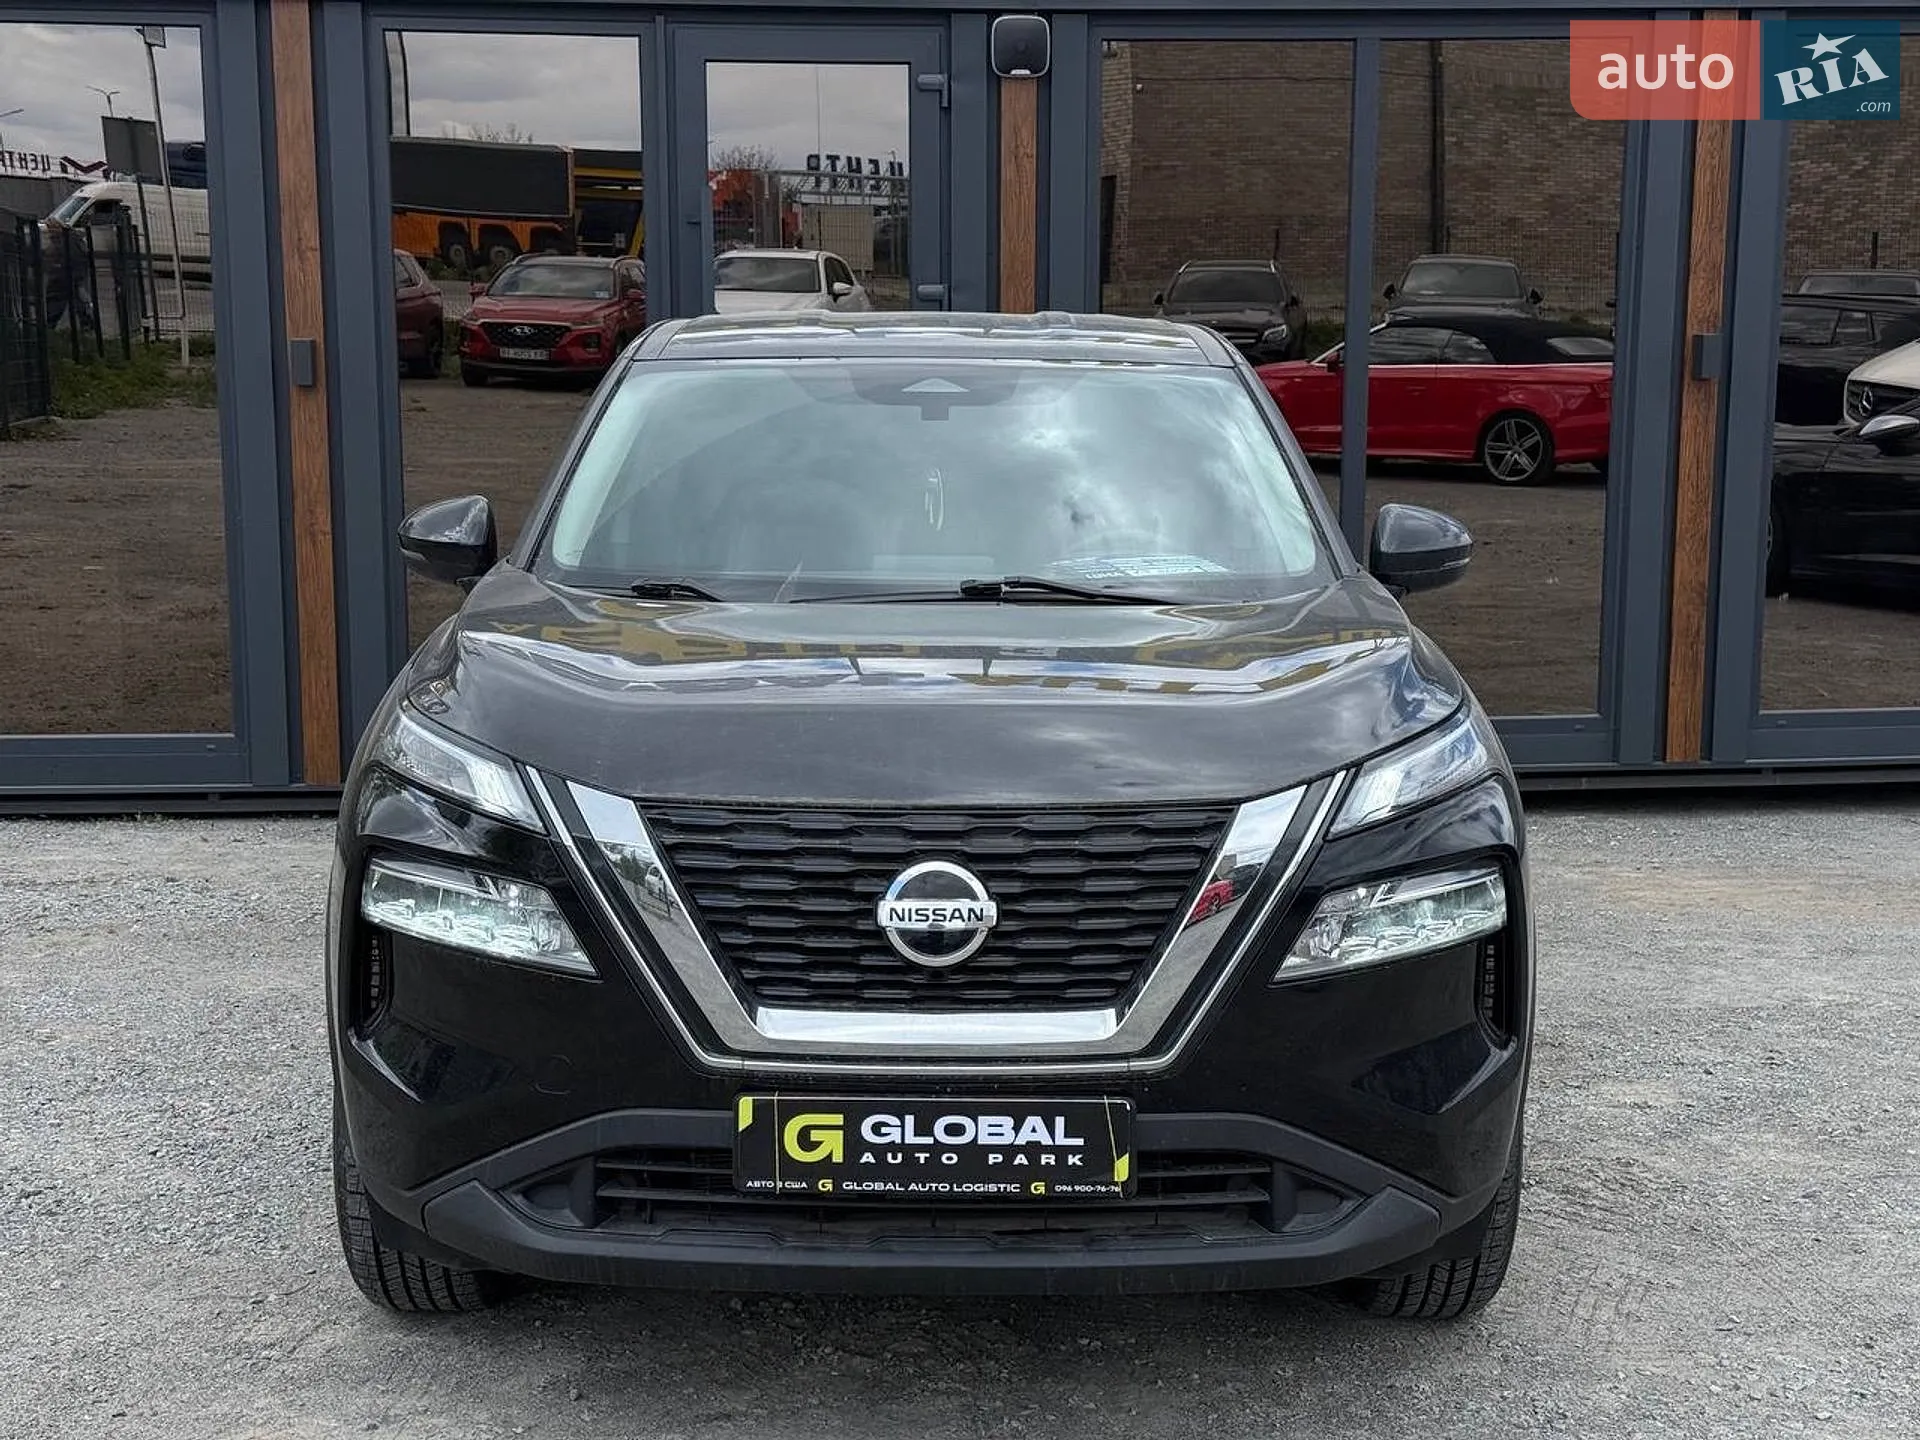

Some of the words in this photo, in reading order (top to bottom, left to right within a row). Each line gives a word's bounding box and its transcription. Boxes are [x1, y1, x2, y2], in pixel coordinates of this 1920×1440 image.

[889, 907, 984, 923] NISSAN
[860, 1114, 1085, 1146] GLOBAL
[859, 1152, 959, 1165] AUTO
[988, 1153, 1085, 1166] PARK
[842, 1181, 905, 1191] GLOBAL
[907, 1182, 950, 1192] AUTO
[953, 1183, 1021, 1193] LOGISTIC
